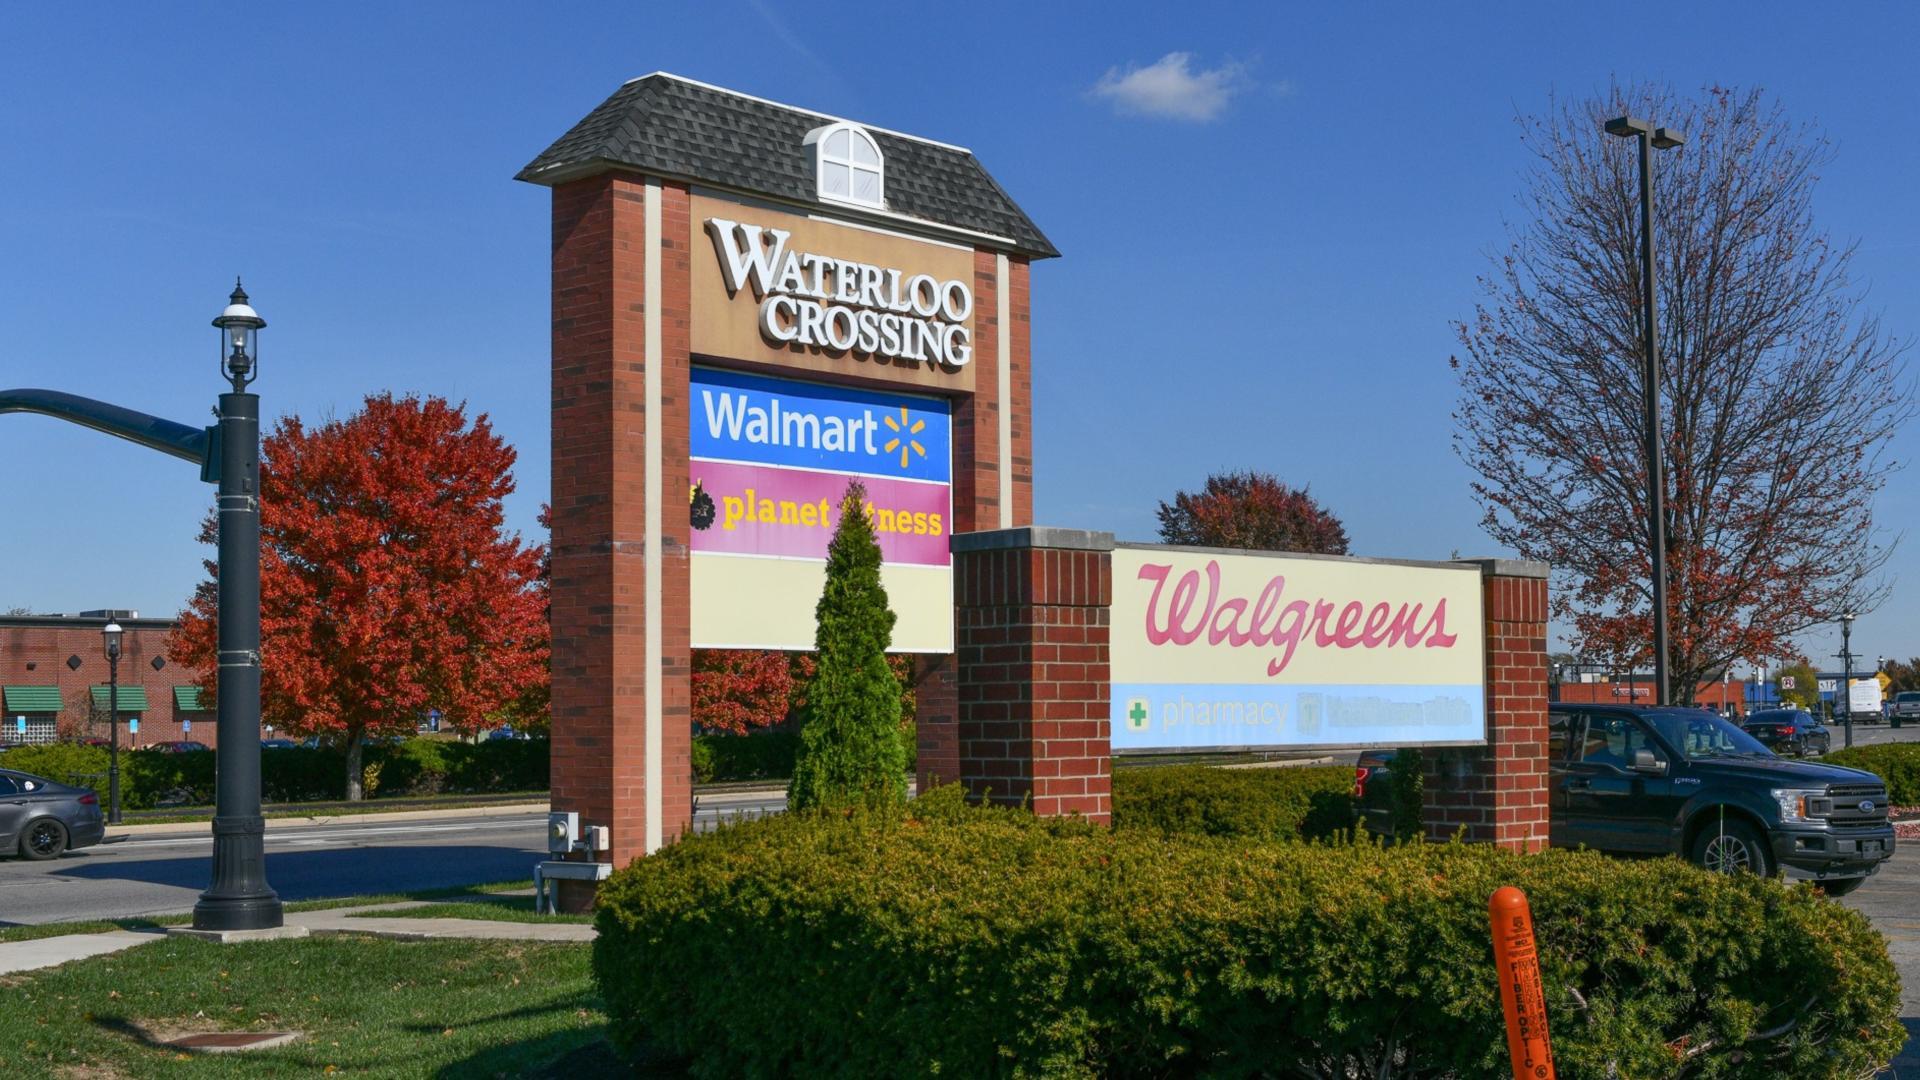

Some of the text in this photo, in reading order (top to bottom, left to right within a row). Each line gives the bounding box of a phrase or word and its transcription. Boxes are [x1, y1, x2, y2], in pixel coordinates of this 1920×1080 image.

[704, 217, 973, 323] WATERLOO
[760, 295, 973, 366] CROSSING
[702, 390, 878, 456] Walmart
[722, 488, 830, 532] planet
[1137, 559, 1458, 677] Walgreens
[1162, 693, 1289, 735] pharmacy
[1511, 961, 1525, 1014] FIBER
[1518, 1016, 1534, 1069] OPTIC
[1530, 956, 1543, 1009] CABLE
